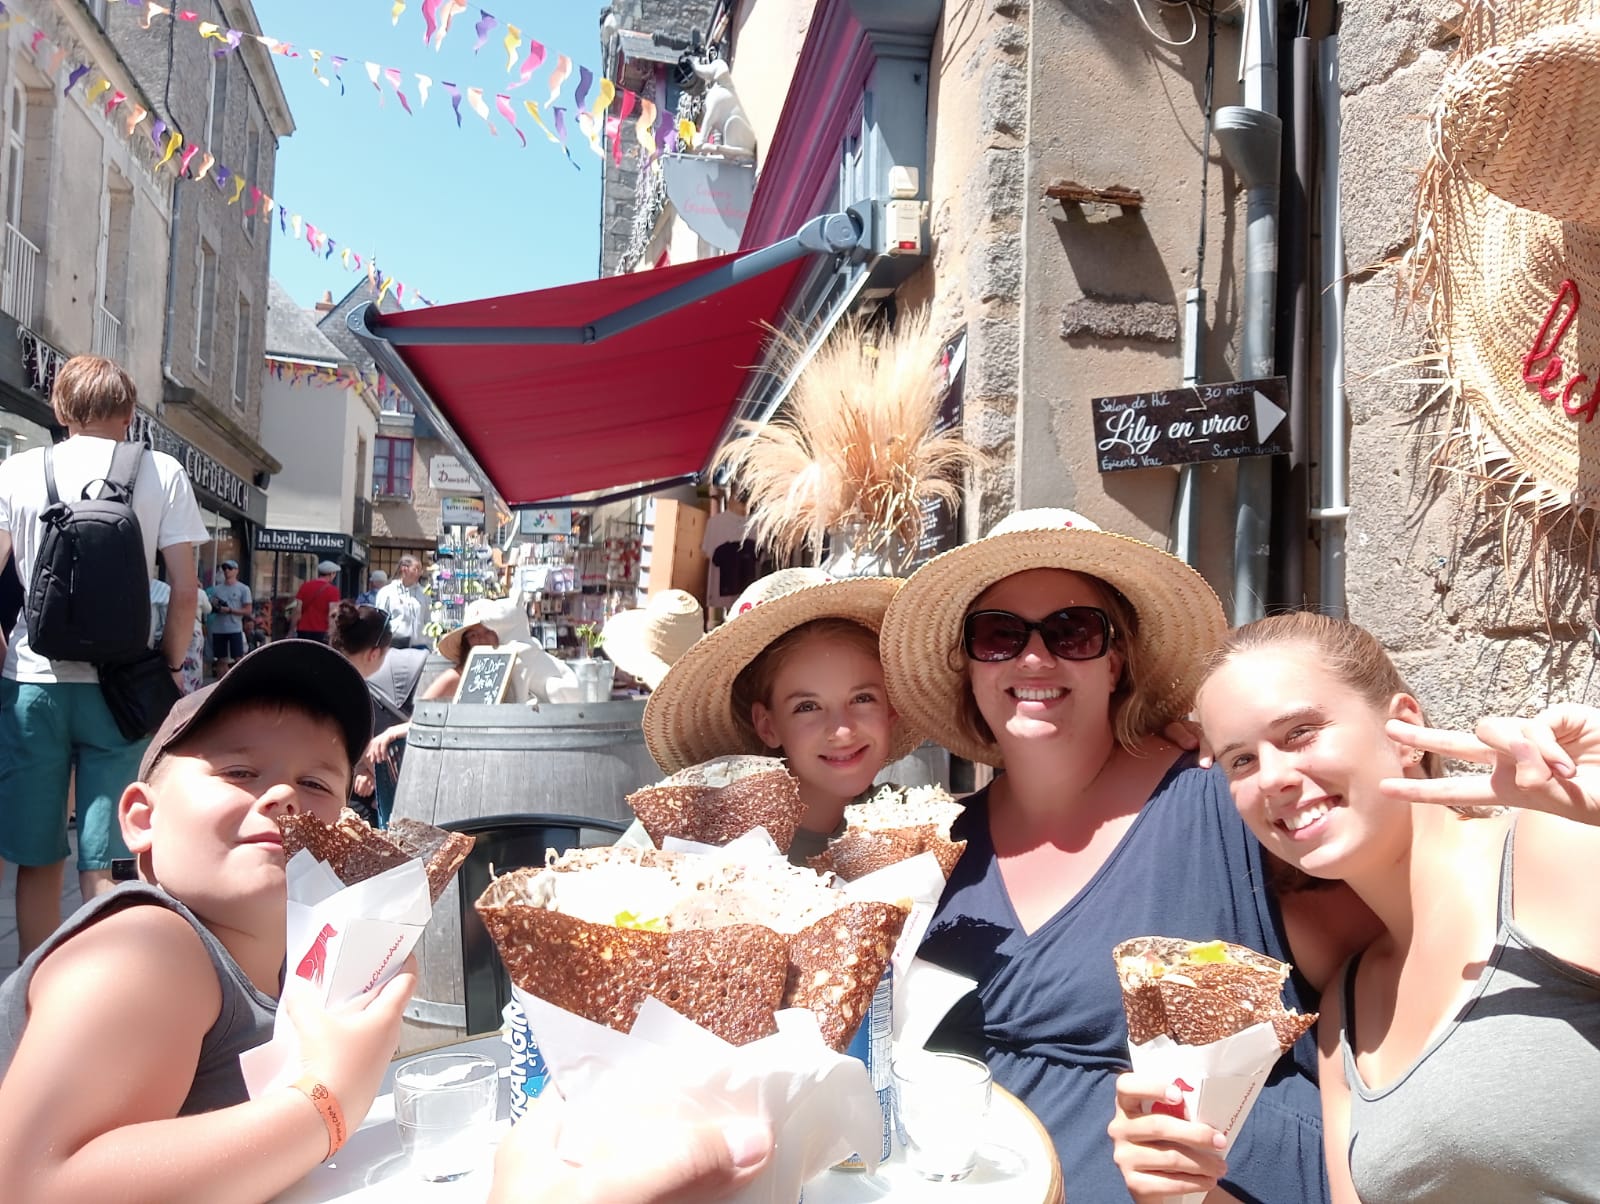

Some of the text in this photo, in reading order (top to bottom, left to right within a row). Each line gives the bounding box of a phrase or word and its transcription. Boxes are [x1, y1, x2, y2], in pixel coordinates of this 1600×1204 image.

[1204, 387, 1221, 401] 30
[1099, 398, 1127, 413] Salon
[1131, 396, 1147, 409] de
[1098, 408, 1251, 455] Lily en vrac
[1211, 443, 1231, 457] Sur
[1141, 455, 1163, 467] Vrac
[258, 531, 345, 549] la belle-iloise
